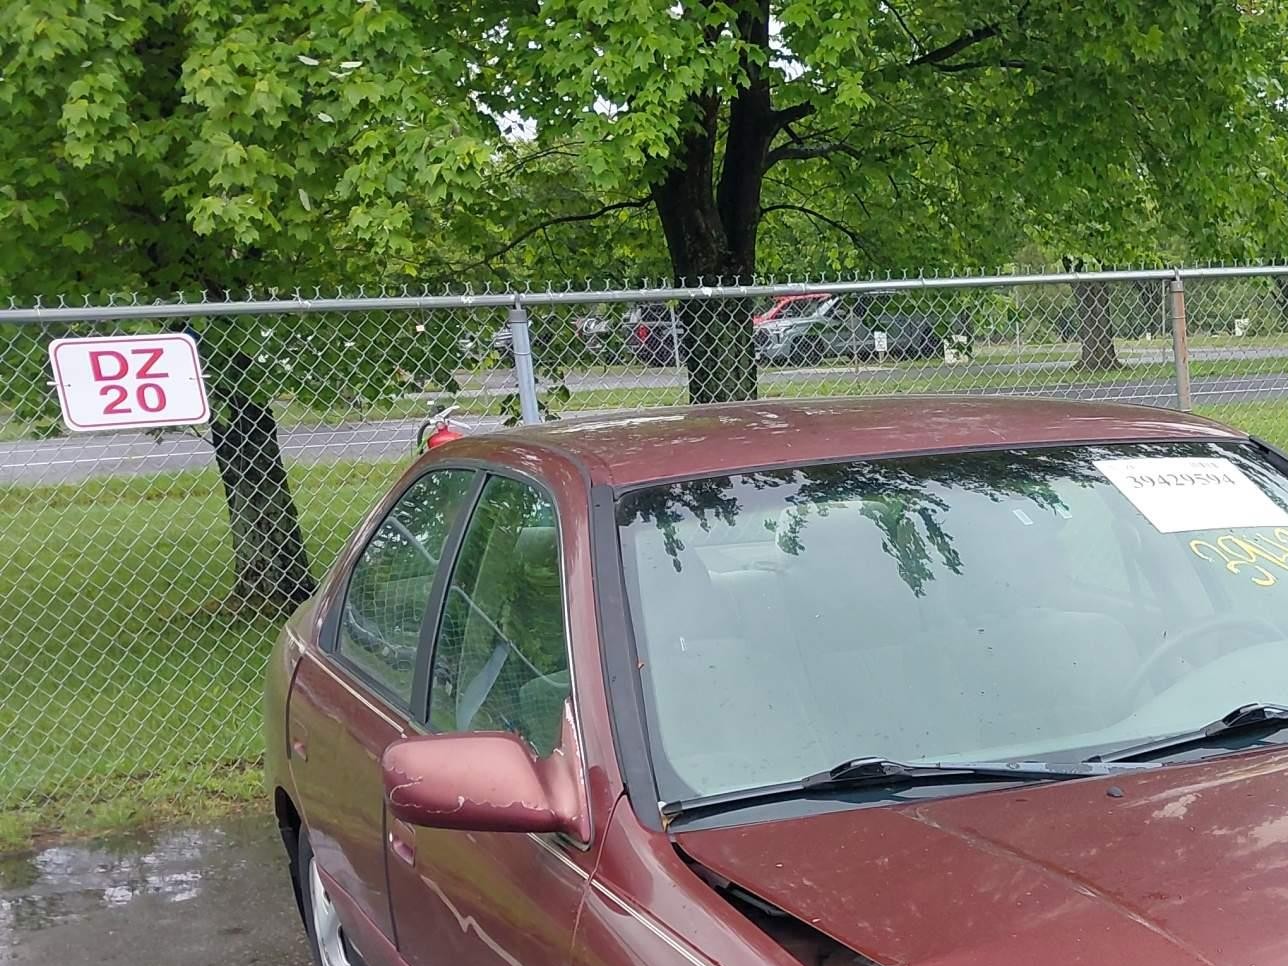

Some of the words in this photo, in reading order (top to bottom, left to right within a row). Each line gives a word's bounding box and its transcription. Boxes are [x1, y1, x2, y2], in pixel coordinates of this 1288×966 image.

[88, 348, 169, 382] DZ
[99, 383, 167, 414] 20
[1125, 473, 1236, 489] 39429594
